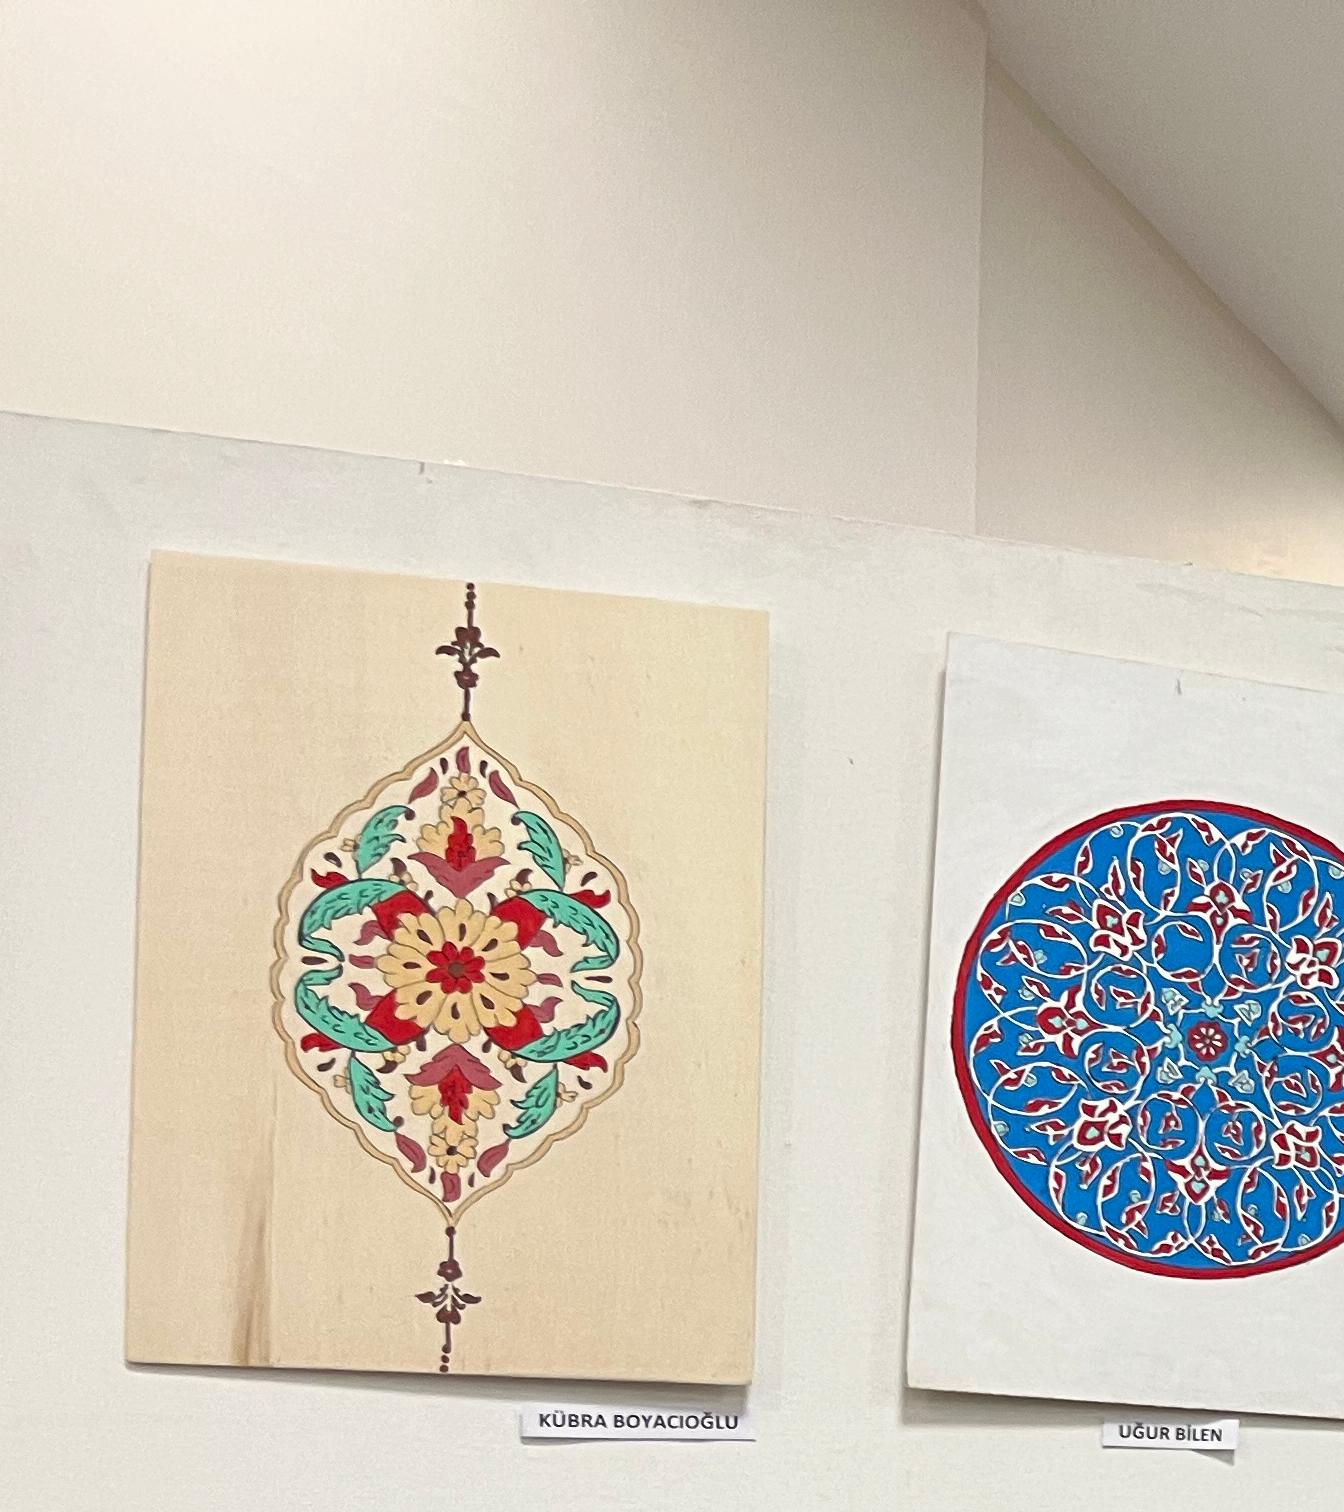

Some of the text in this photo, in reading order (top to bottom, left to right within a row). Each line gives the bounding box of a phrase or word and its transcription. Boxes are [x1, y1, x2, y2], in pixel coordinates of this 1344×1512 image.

[539, 1410, 738, 1430] KÜBRA BOYACIOĞLU
[1119, 1422, 1222, 1442] UĞUR BİLEN
